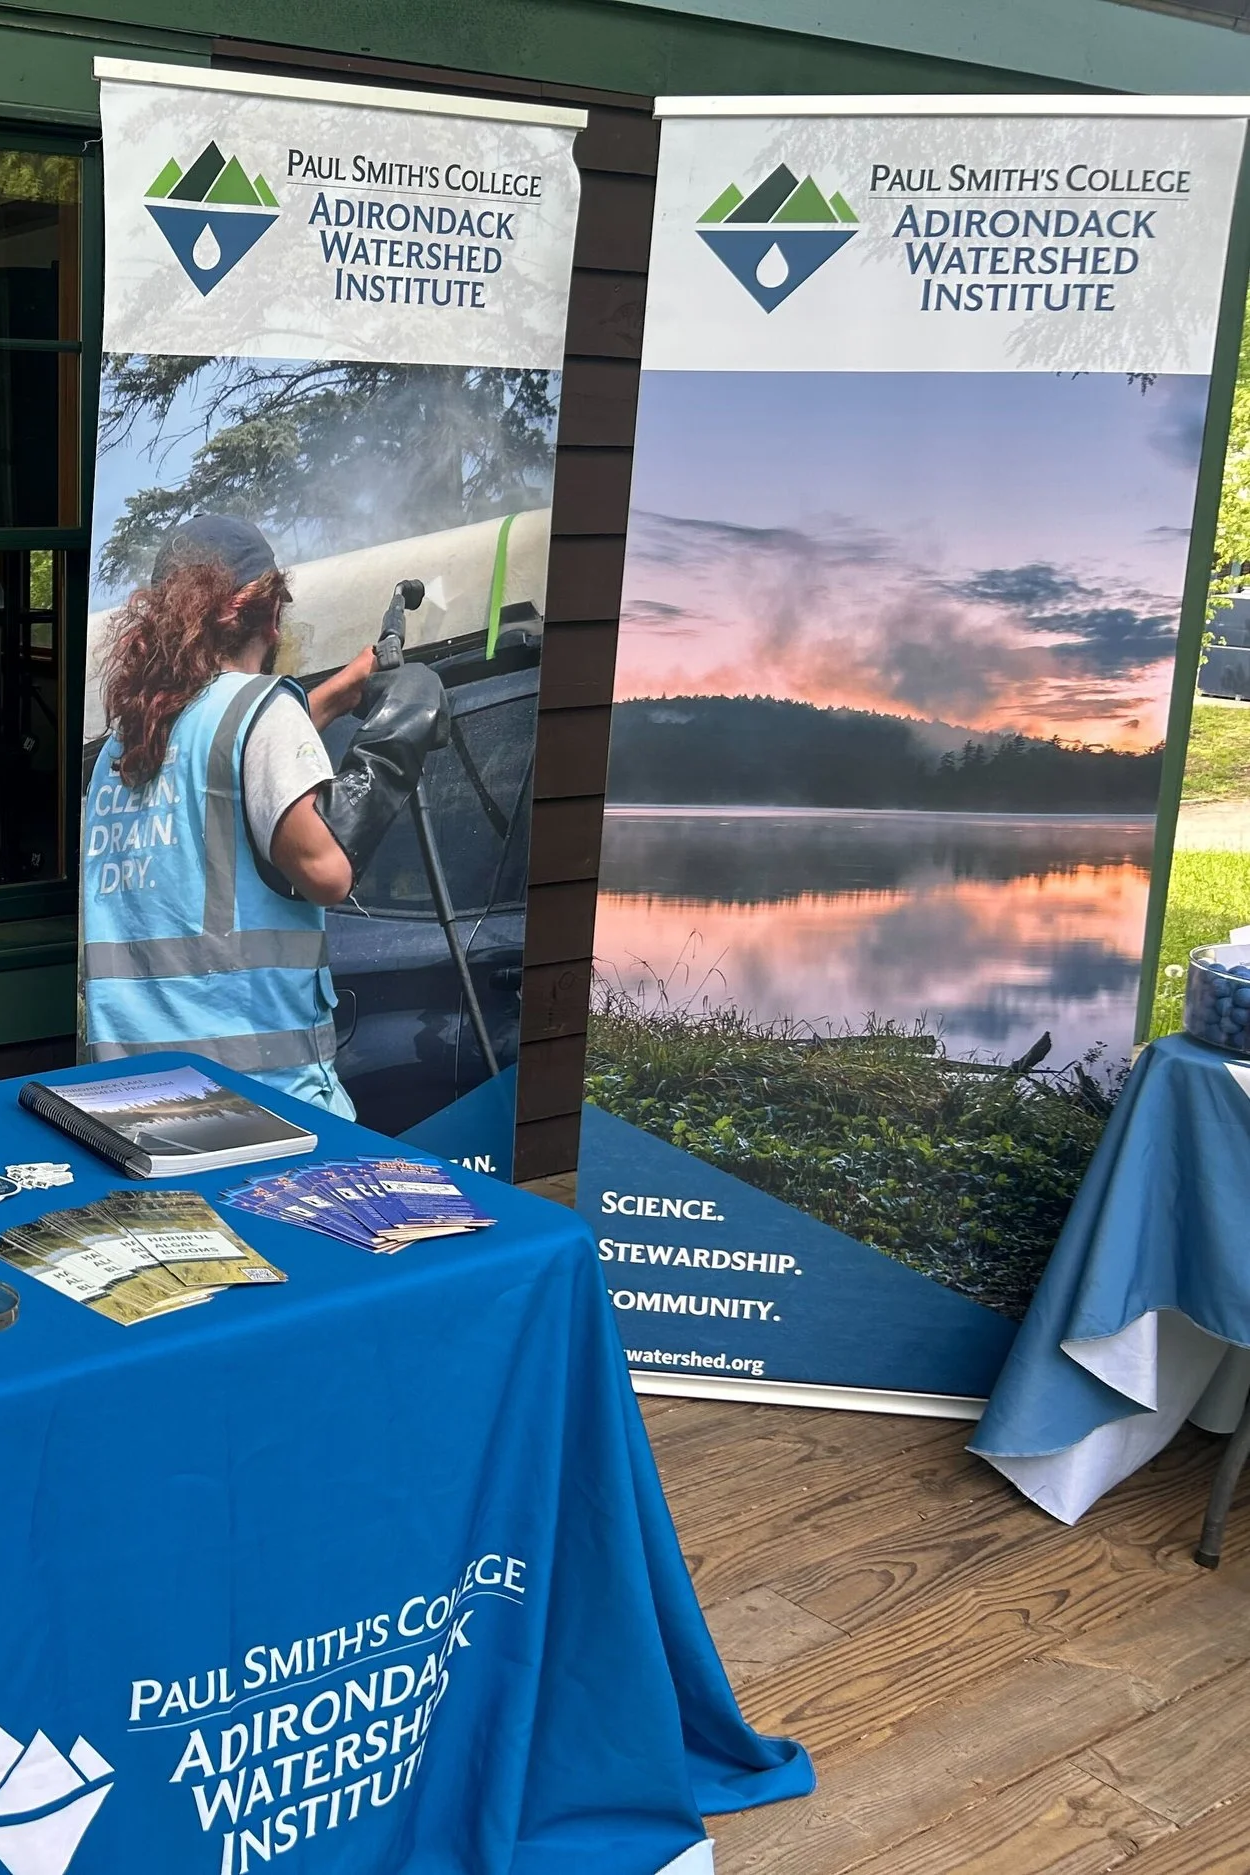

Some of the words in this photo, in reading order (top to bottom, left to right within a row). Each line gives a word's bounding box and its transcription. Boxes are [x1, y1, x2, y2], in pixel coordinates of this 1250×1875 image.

[287, 149, 347, 181] PAUL
[352, 155, 440, 189] SMITH'S
[445, 164, 542, 197] COLLEGE
[869, 164, 941, 192] PAUL
[948, 164, 1059, 192] SMITH'S
[1066, 164, 1191, 193] COLLEGE
[308, 192, 515, 240] ADIRONDACK
[891, 204, 1157, 239] ADIRONDACK
[319, 230, 502, 274] WATERSHED
[905, 241, 1139, 275] WATERSHED
[335, 268, 486, 309] INSTITUTE
[920, 278, 1115, 312] INSTITUTE
[87, 813, 178, 856] DRAIN.
[100, 855, 156, 894] DRY.
[449, 1155, 497, 1173] AN.
[601, 1190, 725, 1222] SCIENCE.
[147, 1234, 214, 1242] HARMFUL
[155, 1241, 198, 1249] ALGAL
[160, 1247, 219, 1255] BLOOMS
[598, 1238, 803, 1275] STEWARDSHIP.
[607, 1289, 781, 1322] OMMUNITY.
[624, 1349, 765, 1376] watershed.org
[129, 1668, 236, 1721] PAUL
[243, 1614, 391, 1689] SMITH'S
[191, 1670, 449, 1831] WATERSHED
[220, 1729, 429, 1875] INSTITUT
